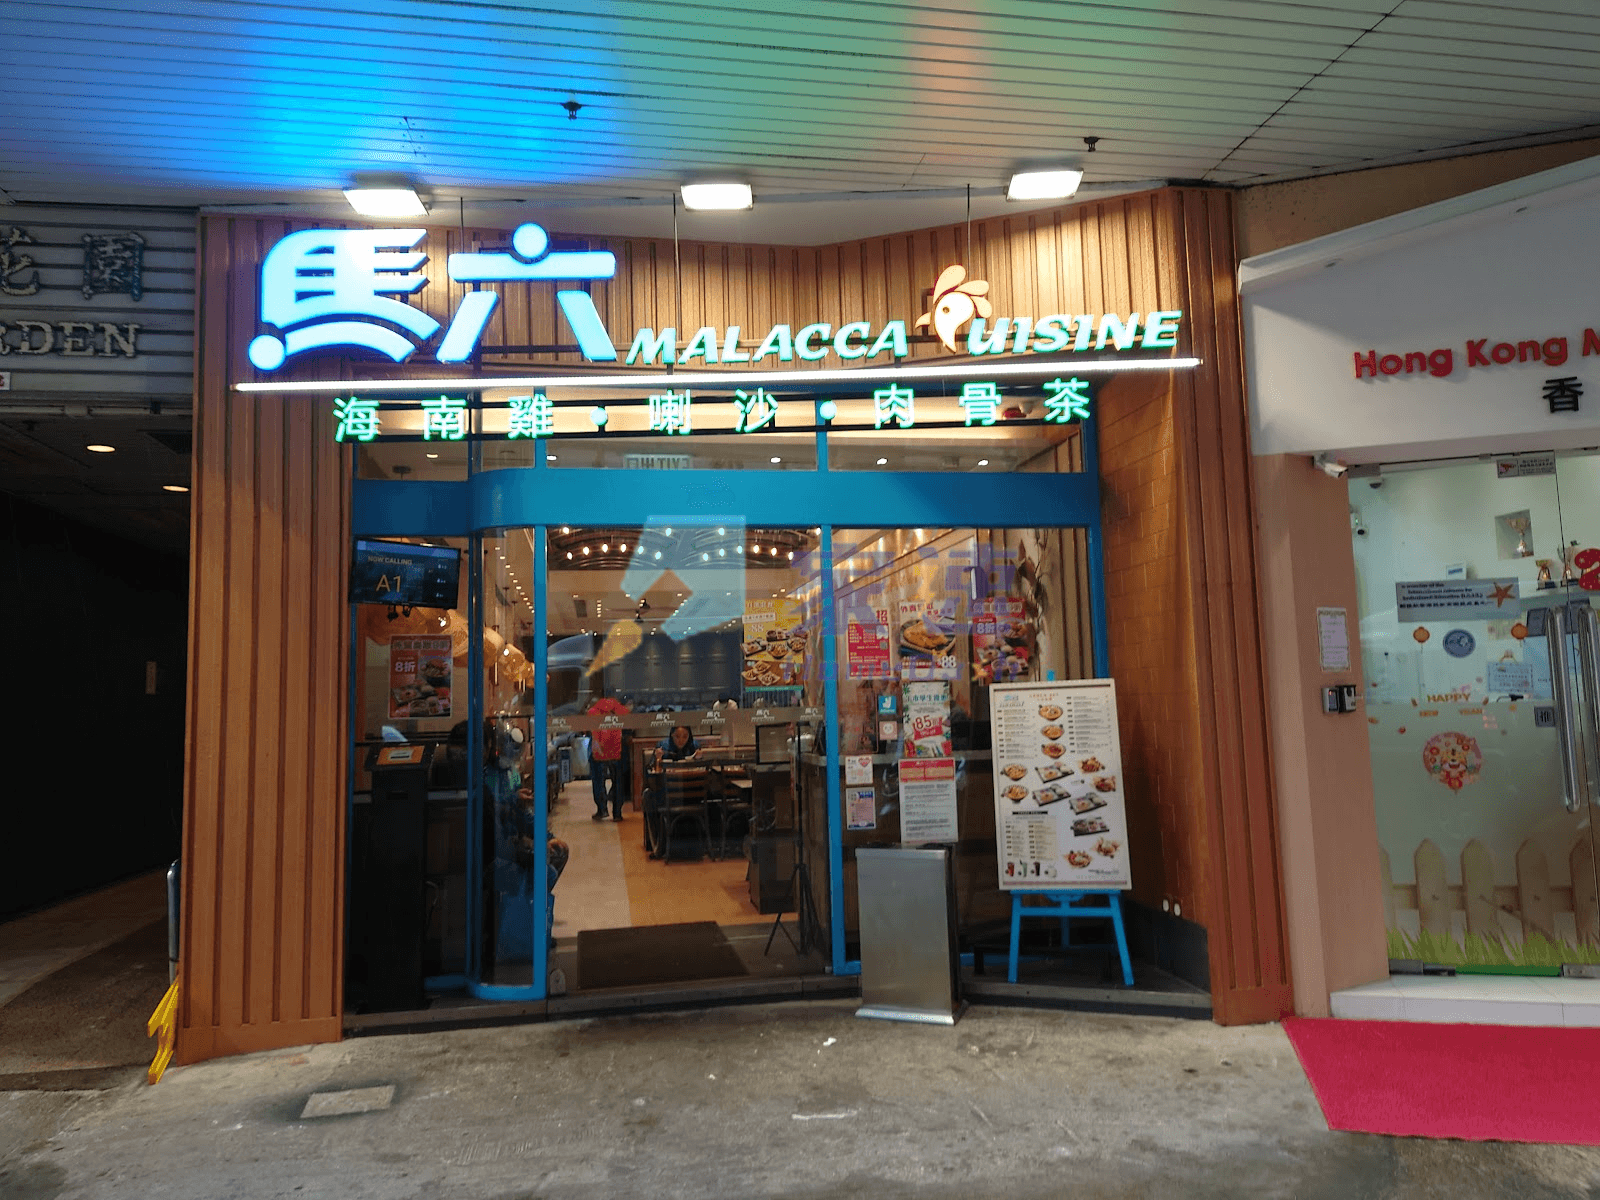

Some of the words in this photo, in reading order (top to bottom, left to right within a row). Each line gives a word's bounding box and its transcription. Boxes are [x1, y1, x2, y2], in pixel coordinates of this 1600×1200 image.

[248, 222, 617, 371] 馬六
[625, 320, 908, 365] MALACCA
[1353, 348, 1454, 379] Hong
[1466, 337, 1568, 367] Kong
[1542, 376, 1584, 413] 香
[375, 574, 401, 593] A1
[1427, 693, 1470, 702] HAPPY
